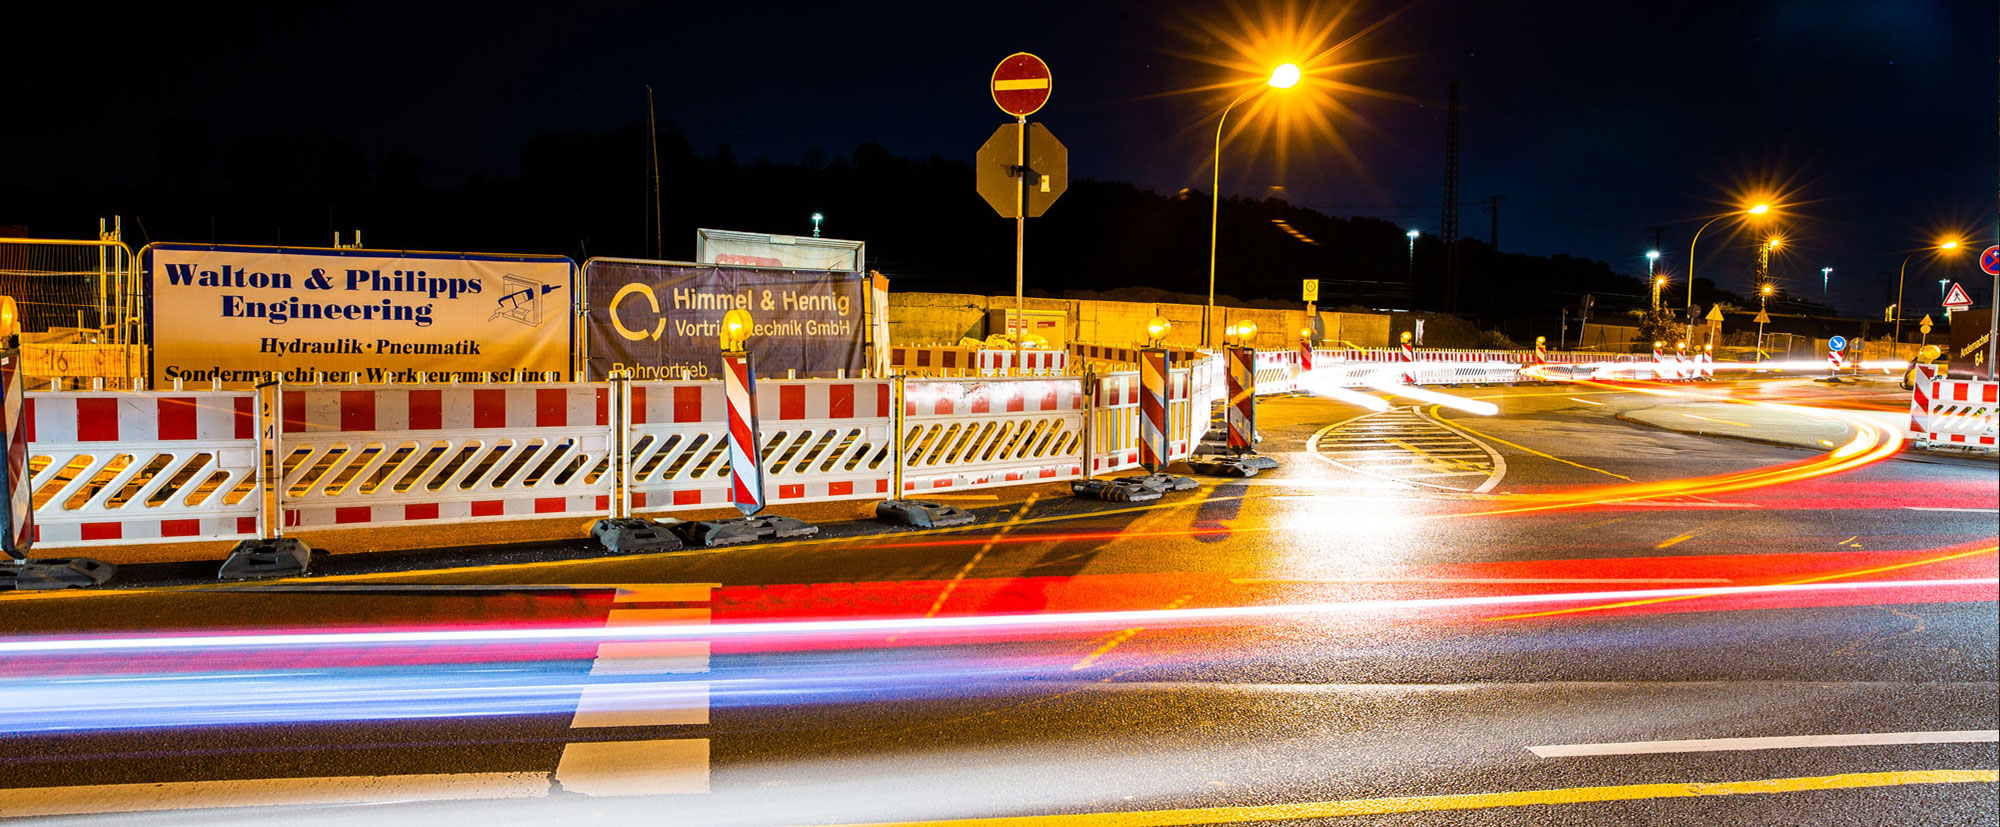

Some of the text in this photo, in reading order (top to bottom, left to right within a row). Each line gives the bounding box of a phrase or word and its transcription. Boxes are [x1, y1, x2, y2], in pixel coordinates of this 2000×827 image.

[164, 264, 483, 300] Walton & Philipps
[220, 295, 434, 327] Engineering
[673, 287, 850, 316] Himmel & Hennig
[805, 319, 850, 336] GmbH
[259, 337, 481, 357] Hydraulik Pneumatik
[1974, 349, 1984, 367] 64
[164, 365, 351, 383] Sondermachinen
[612, 361, 708, 379] Rohrvortrieb
